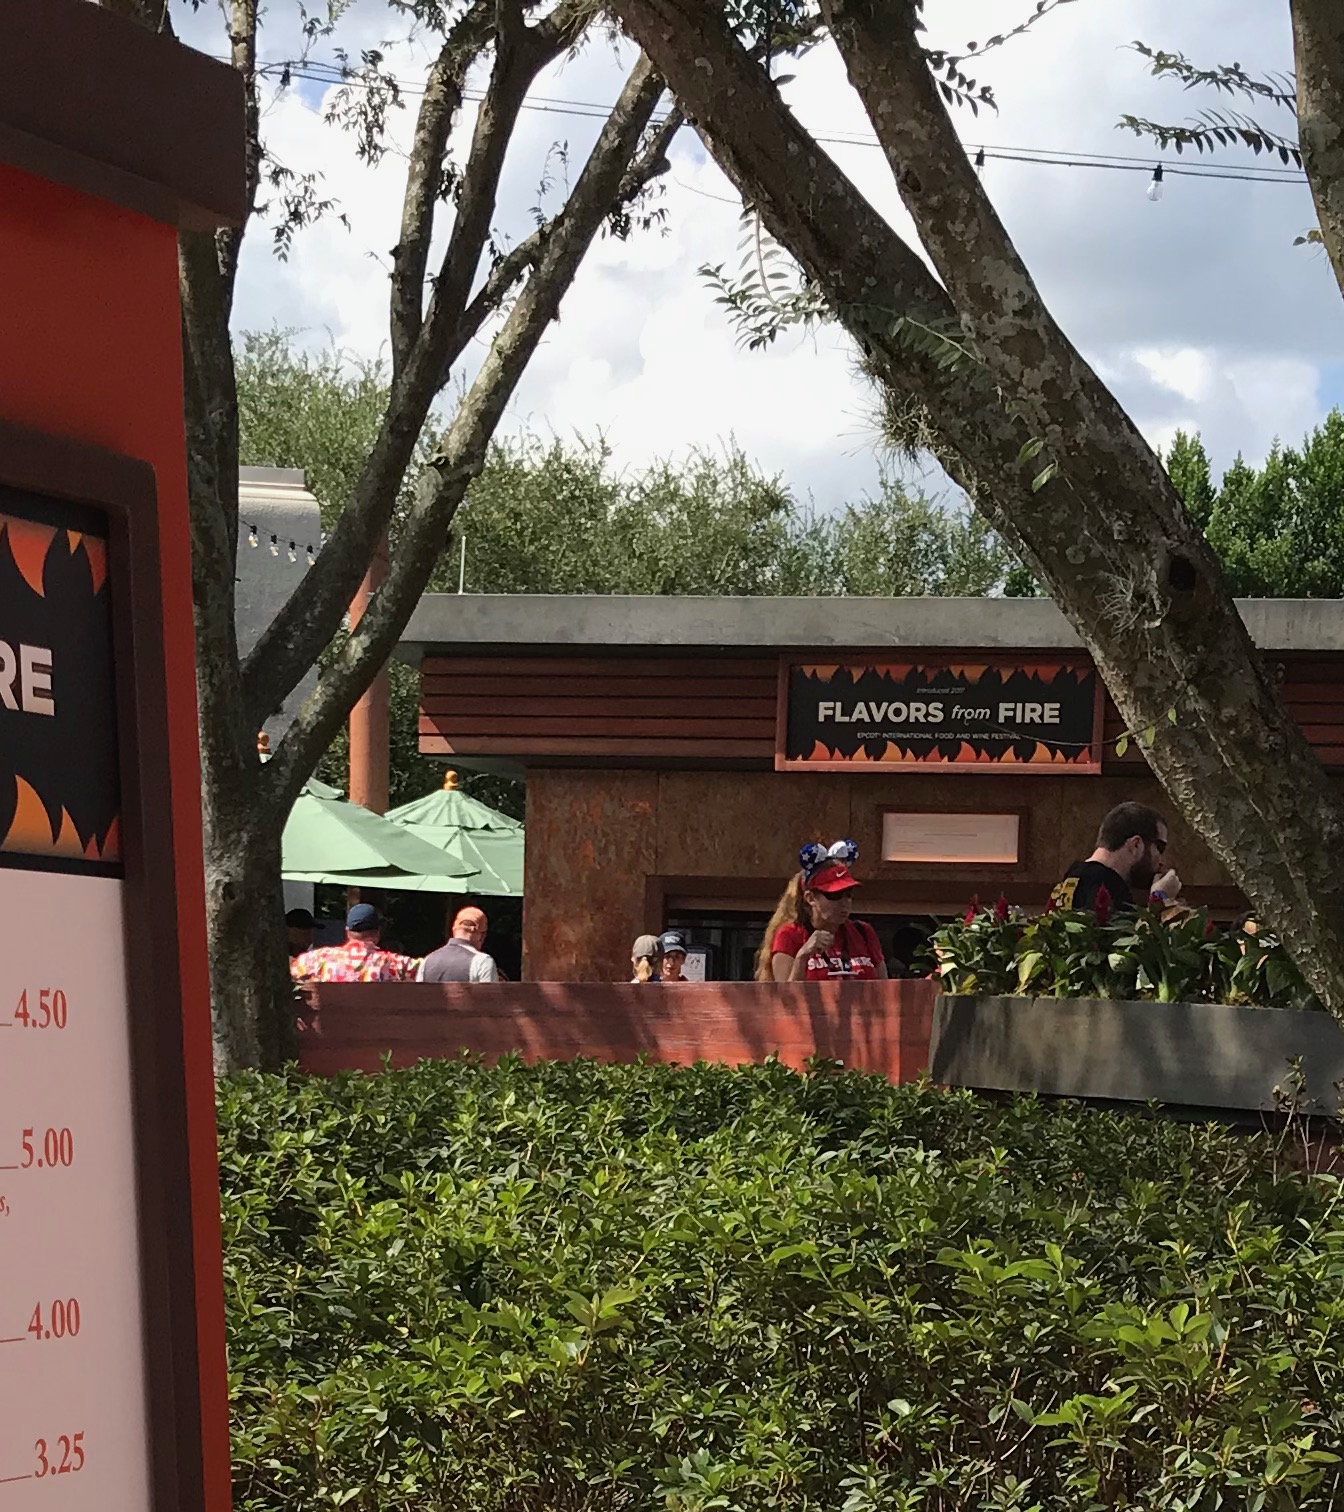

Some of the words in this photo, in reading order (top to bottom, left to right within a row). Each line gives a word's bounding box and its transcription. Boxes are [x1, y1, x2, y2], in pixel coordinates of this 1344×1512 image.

[817, 701, 945, 724] FLAVORS
[951, 704, 992, 722] from
[997, 702, 1061, 725] FIRE
[13, 986, 68, 1030] 4.50
[20, 1125, 74, 1169] 5.00
[26, 1296, 81, 1341] 4.00
[33, 1429, 85, 1479] 3.25
